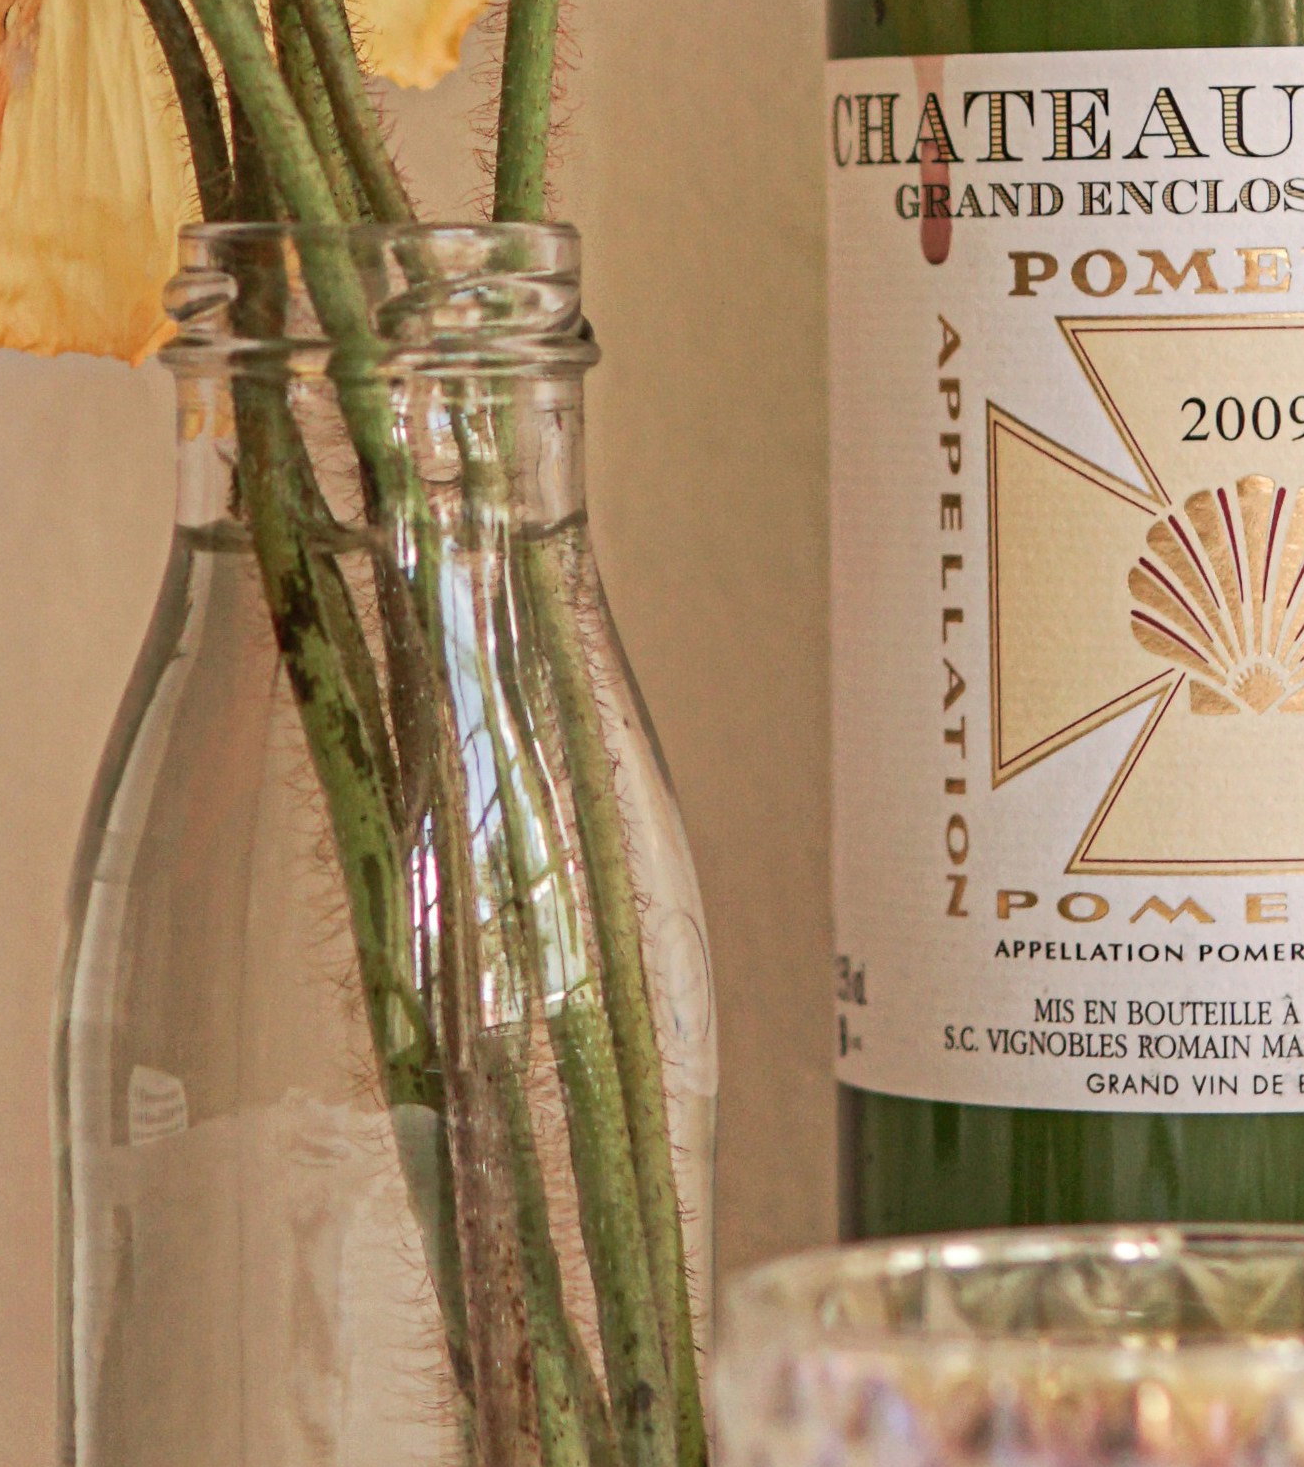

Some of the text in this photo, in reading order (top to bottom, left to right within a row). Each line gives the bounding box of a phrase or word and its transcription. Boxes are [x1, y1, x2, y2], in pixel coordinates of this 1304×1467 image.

[833, 83, 1304, 167] CHATEAU
[896, 181, 1065, 220] GRAND
[937, 312, 969, 918] APPELLATION
[994, 939, 1184, 962] APPELLATION
[1034, 998, 1075, 1023] MIS
[1084, 999, 1117, 1025] EN
[1127, 1000, 1272, 1026] BOUTEILLE
[944, 1025, 979, 1051] S.C.
[987, 1029, 1128, 1058] VIGNOBLES
[1137, 1034, 1252, 1059] ROMAIN
[1086, 1073, 1179, 1095] GRAND
[1192, 1075, 1238, 1095] VIN
[1253, 1074, 1283, 1095] DE
